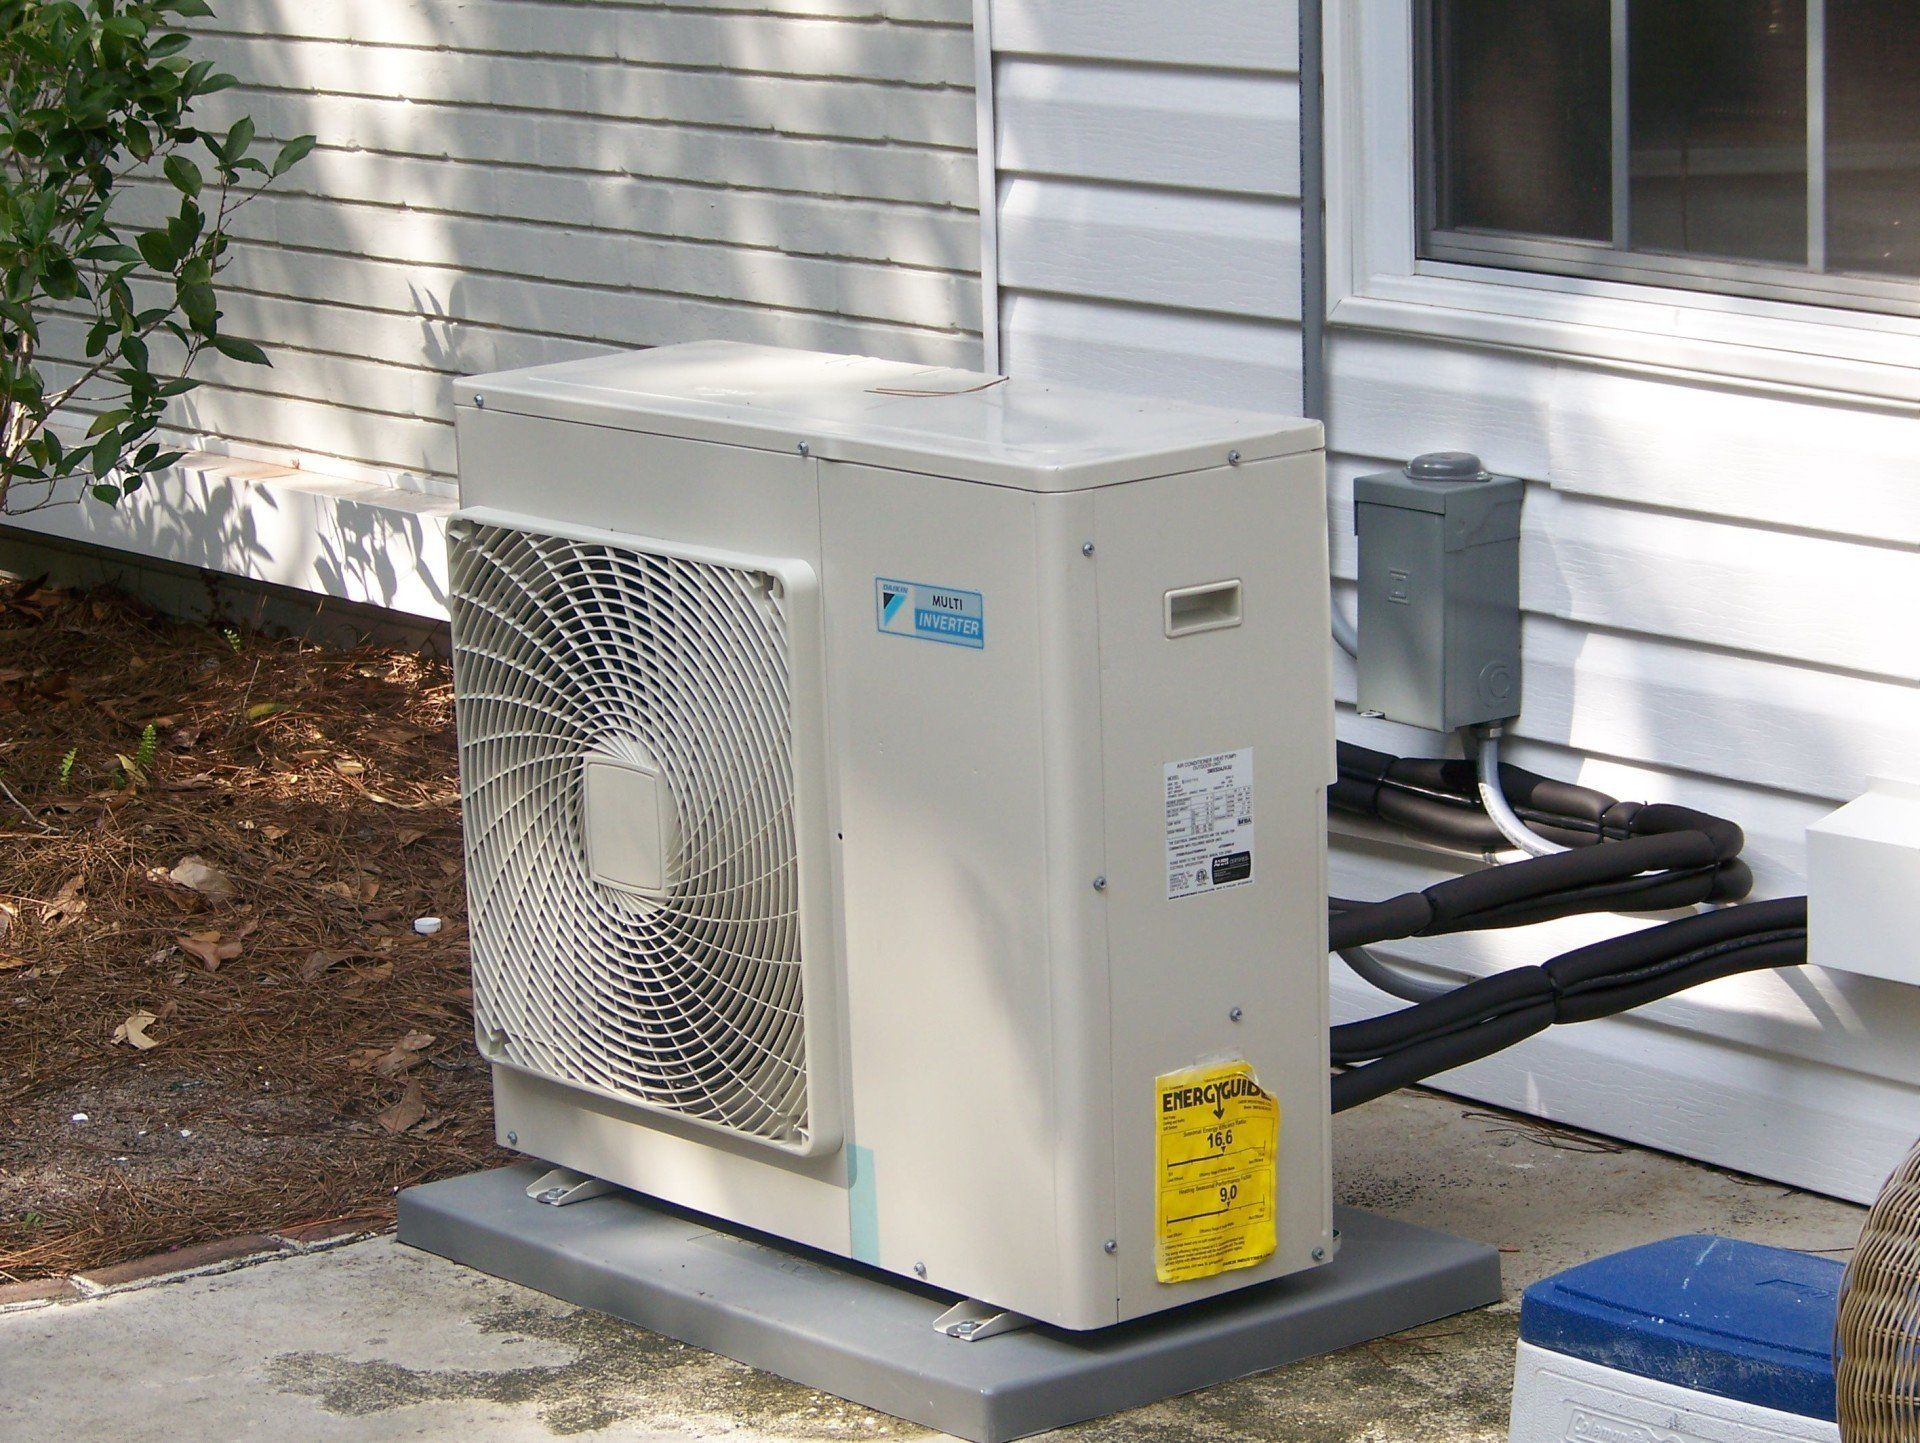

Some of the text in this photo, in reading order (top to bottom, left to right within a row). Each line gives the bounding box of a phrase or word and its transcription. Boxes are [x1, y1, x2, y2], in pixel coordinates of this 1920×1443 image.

[883, 584, 909, 594] DAIKIN
[932, 595, 963, 611] MULTI
[918, 612, 980, 636] INVERTER
[1207, 1129, 1233, 1149] 16.6
[1219, 1184, 1238, 1203] 9.0
